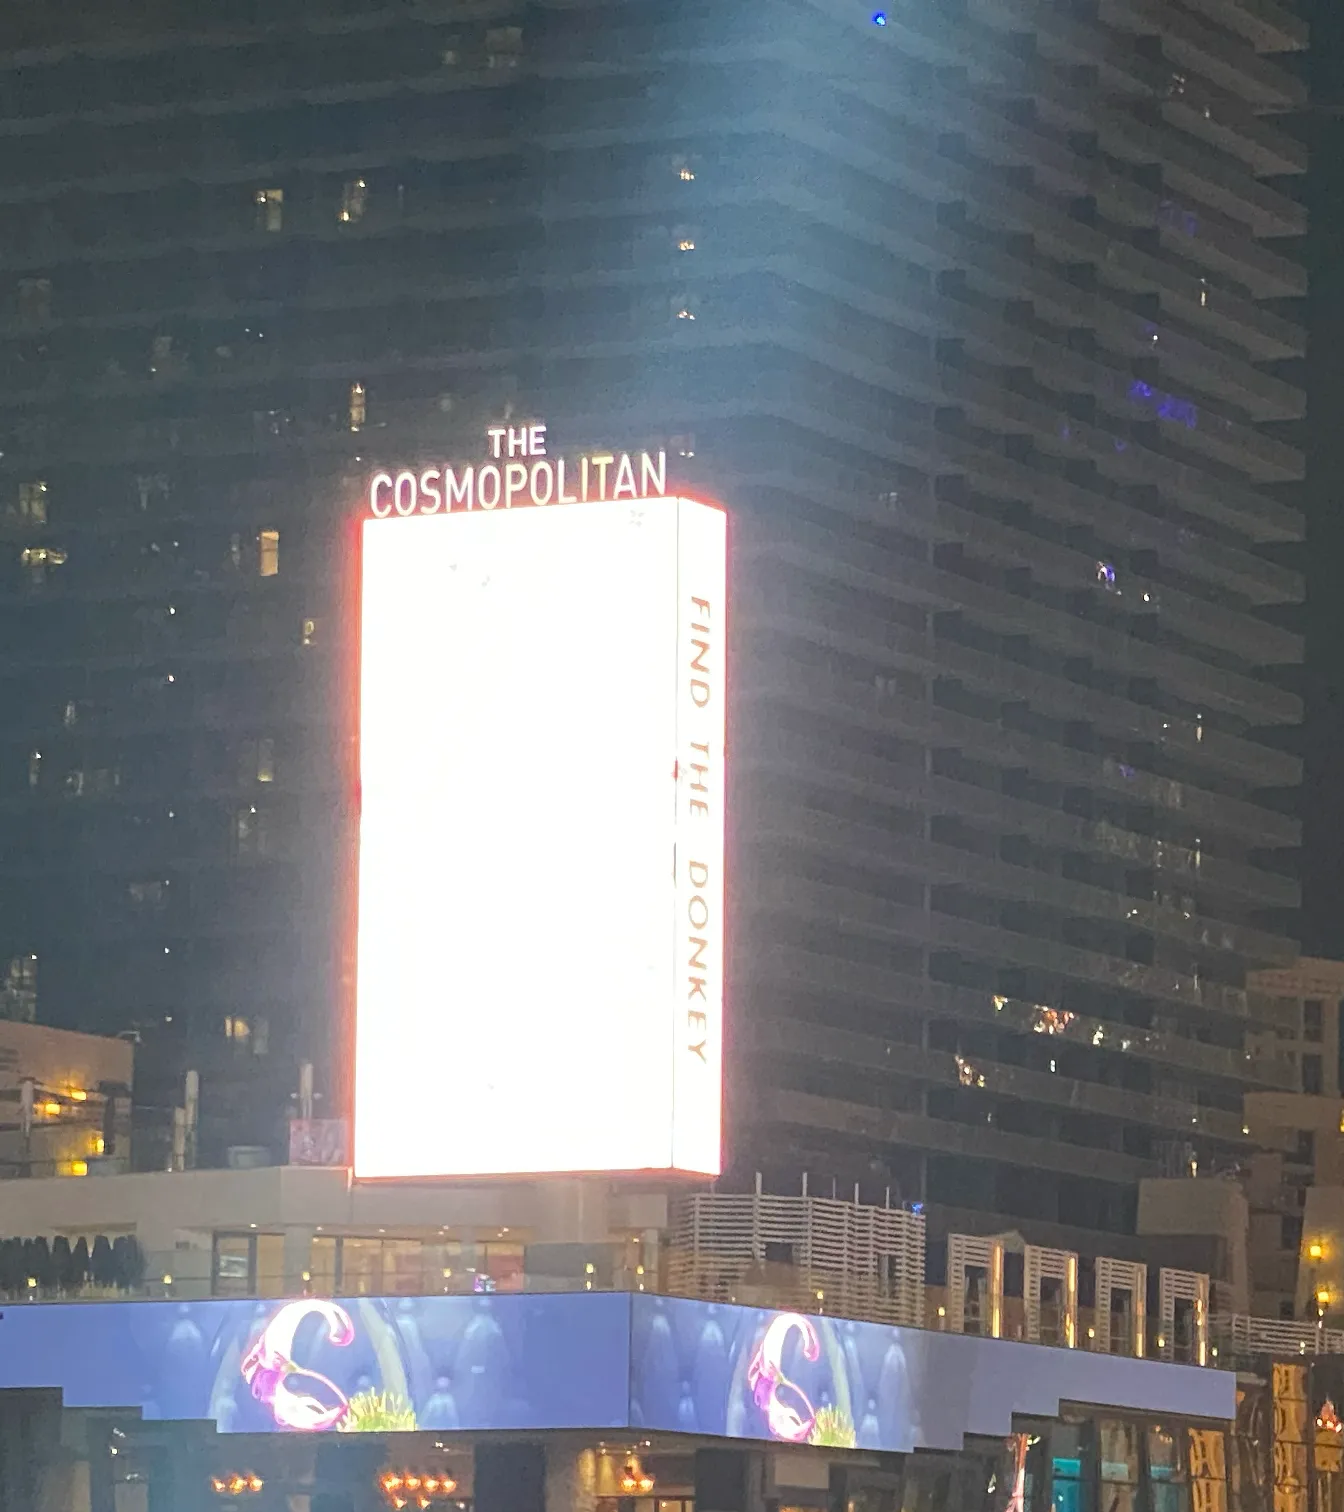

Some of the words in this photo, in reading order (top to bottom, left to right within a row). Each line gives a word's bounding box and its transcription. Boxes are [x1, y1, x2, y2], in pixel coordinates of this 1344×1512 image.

[489, 425, 547, 458] THE
[368, 452, 668, 519] COSMOPOLITAN
[689, 595, 712, 709] FIND
[688, 741, 710, 818] THE
[686, 860, 709, 1065] DONKEY
